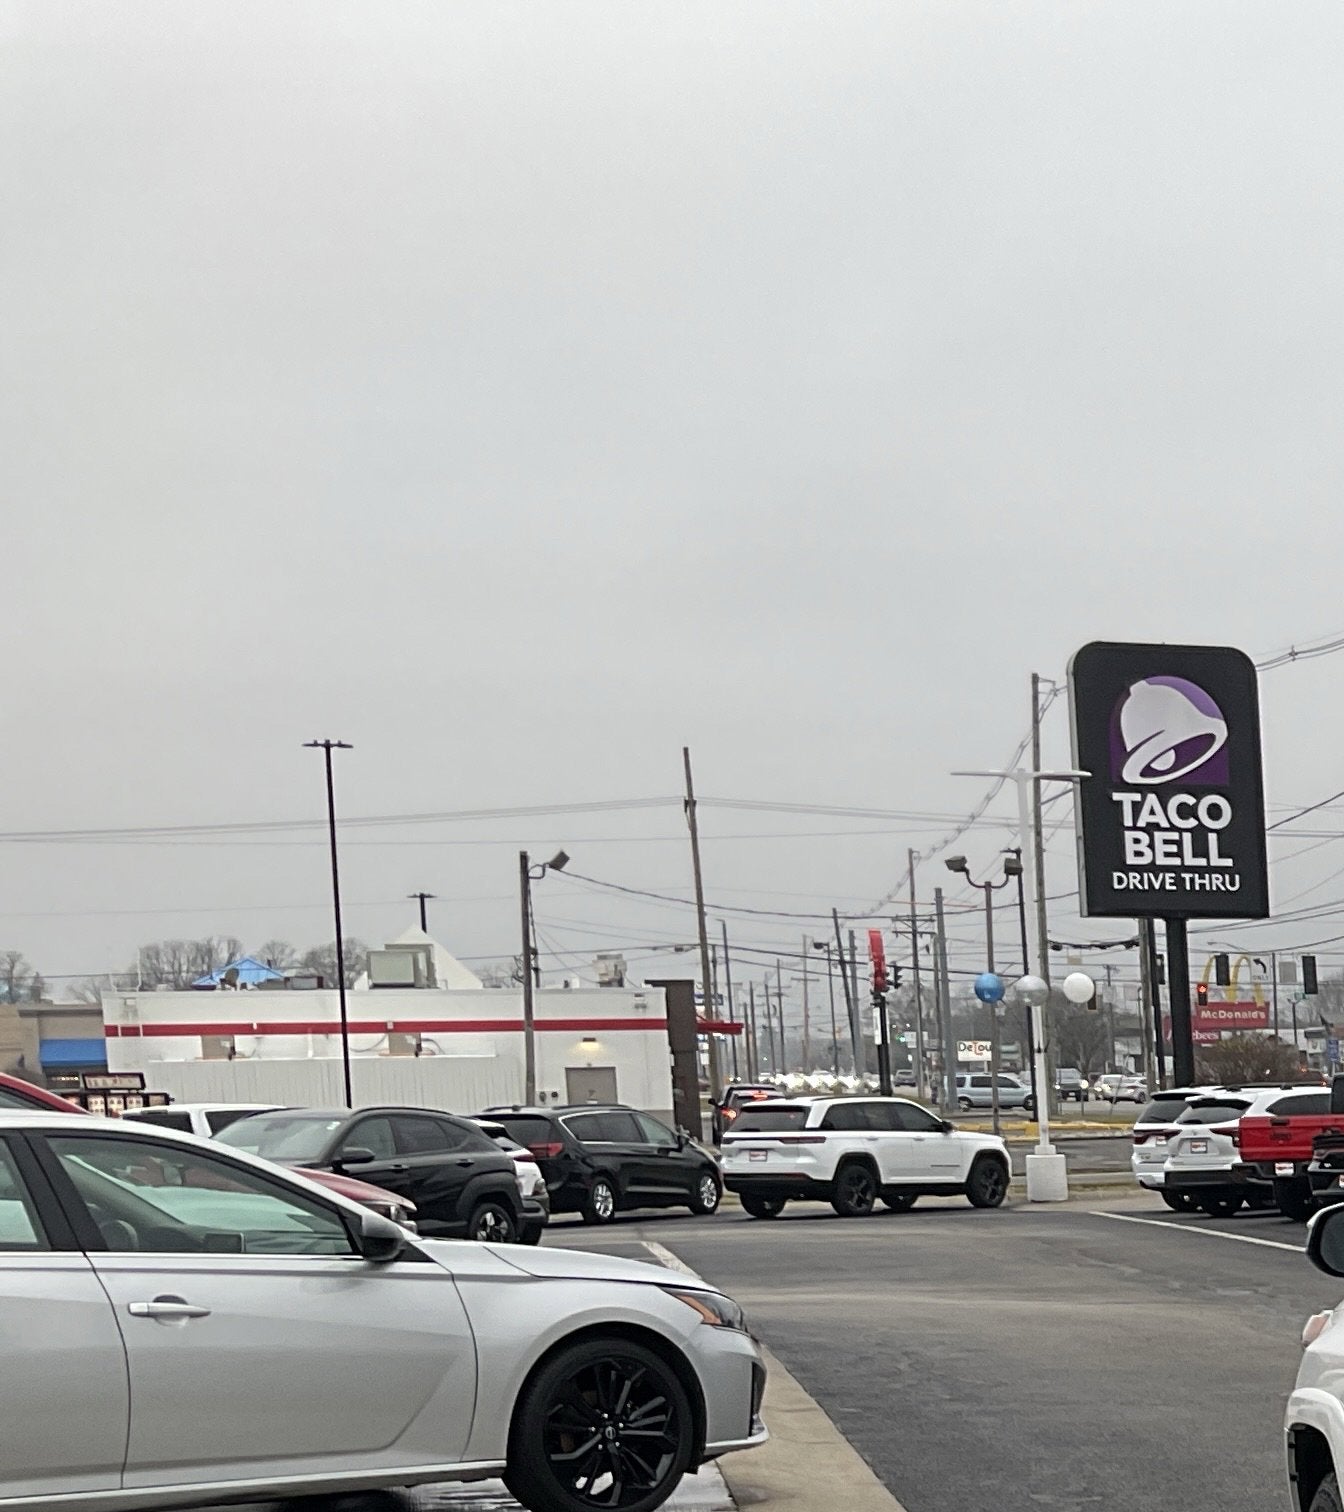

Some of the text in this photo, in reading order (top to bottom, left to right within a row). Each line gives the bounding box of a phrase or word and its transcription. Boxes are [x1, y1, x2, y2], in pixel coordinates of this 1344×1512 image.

[1112, 791, 1232, 830] TACO
[1123, 830, 1234, 867] BELL
[1112, 871, 1241, 892] DRIVE THRU
[1200, 1010, 1266, 1019] McDonald's
[958, 1040, 993, 1056] DeTou
